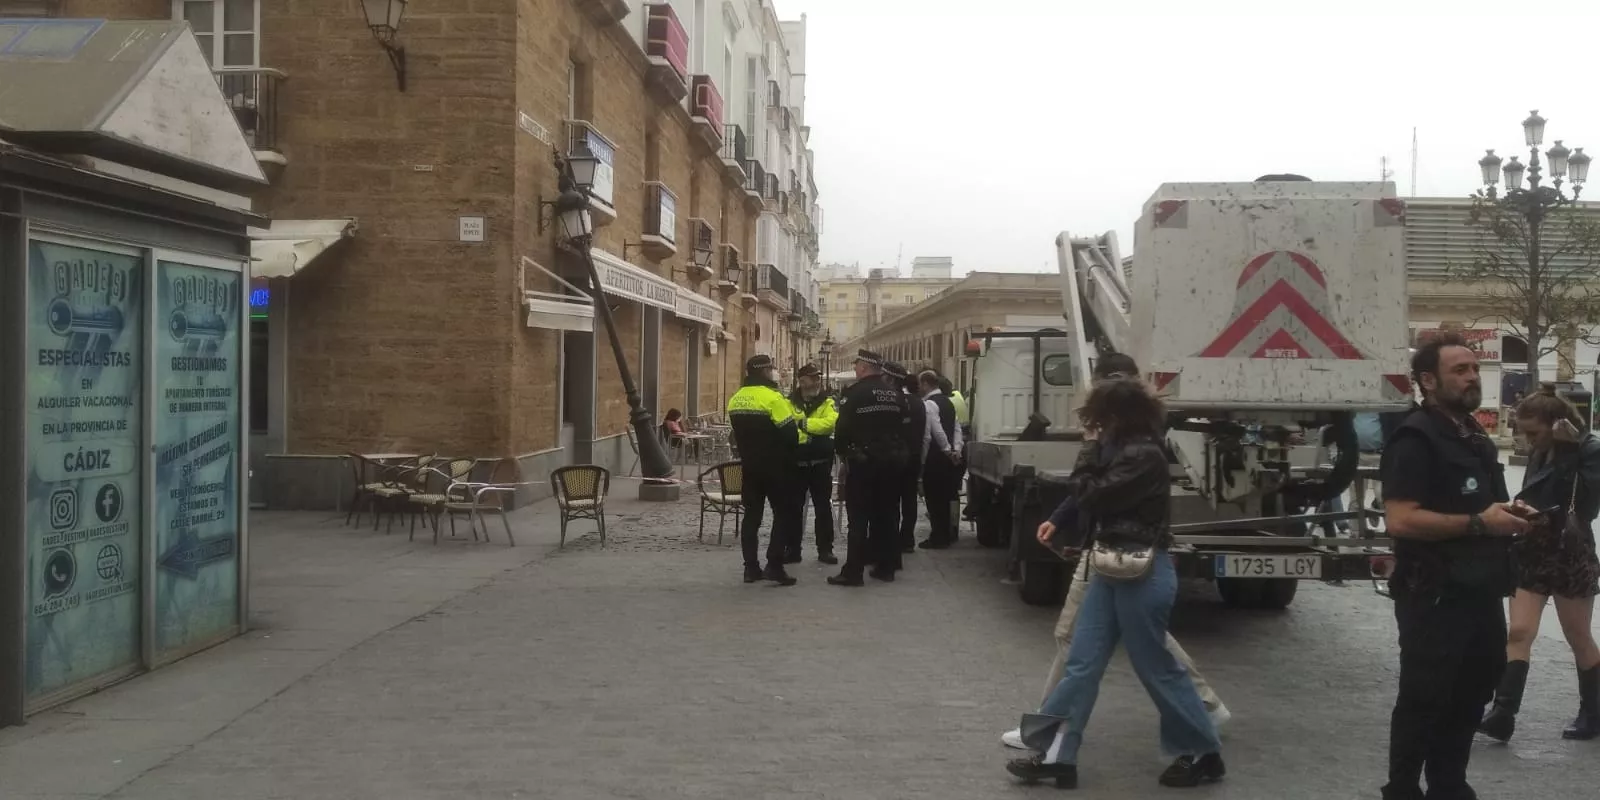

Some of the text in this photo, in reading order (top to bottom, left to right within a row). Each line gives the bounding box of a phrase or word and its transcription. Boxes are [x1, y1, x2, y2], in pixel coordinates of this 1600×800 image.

[38, 348, 132, 367] ESPECIALISTAS
[171, 356, 228, 371] GESTIONAMOS
[81, 378, 93, 390] EN
[38, 396, 134, 409] ALQUILER VACACIONAL
[42, 419, 128, 435] EN LA PROVINCIA DE
[63, 446, 111, 472] CÁDIZ
[1233, 558, 1276, 575] 1735
[1284, 558, 1316, 575] LGY
